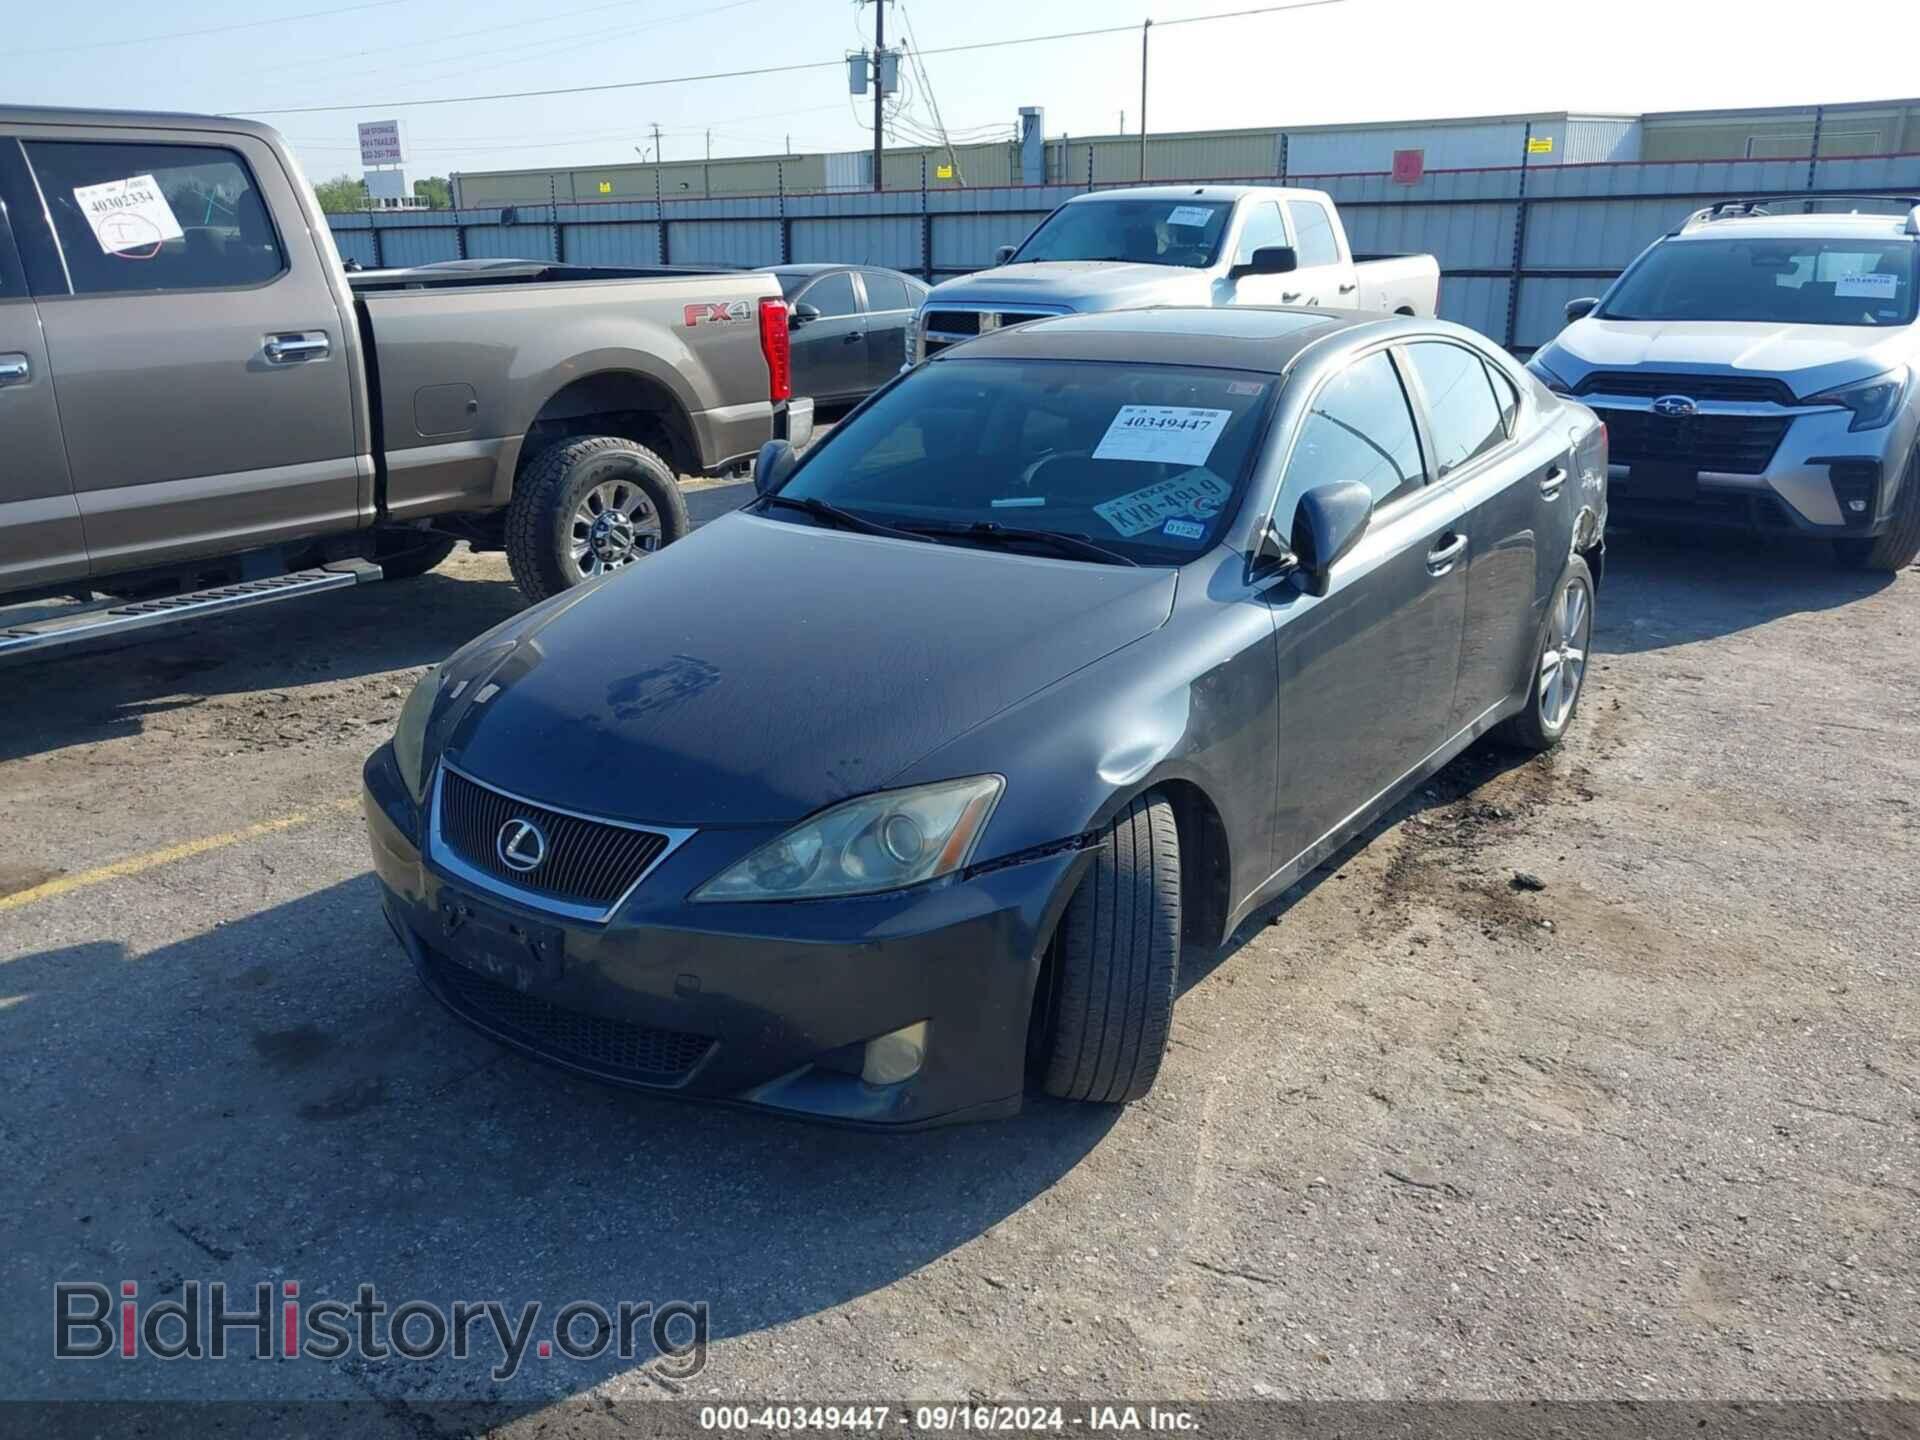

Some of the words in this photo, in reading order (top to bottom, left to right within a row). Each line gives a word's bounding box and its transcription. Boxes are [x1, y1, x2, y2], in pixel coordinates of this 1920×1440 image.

[91, 191, 154, 212] 40302334
[684, 301, 751, 327] FX4
[1123, 416, 1211, 431] 40349447
[1129, 483, 1176, 500] TEXAS
